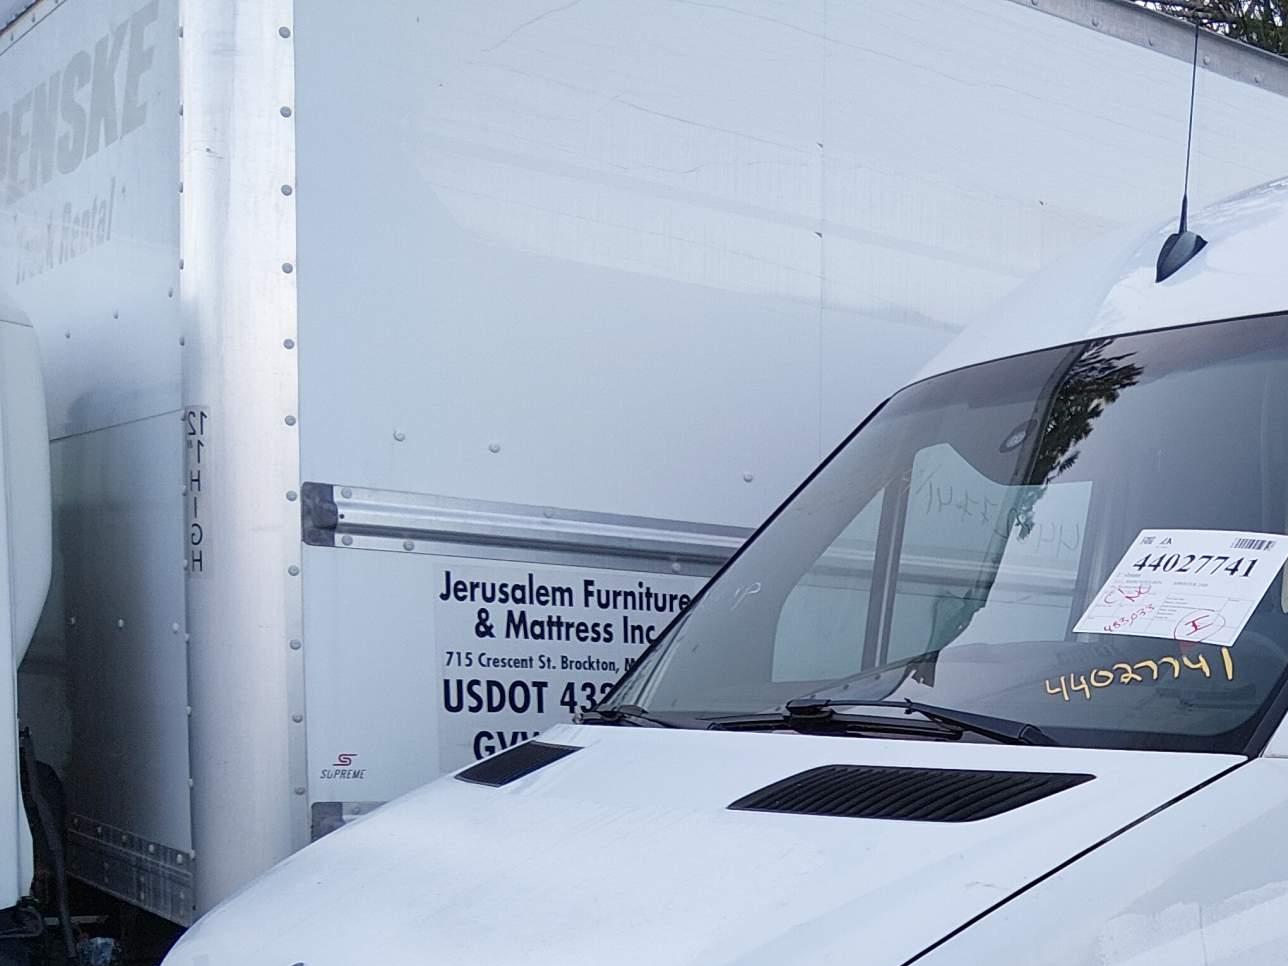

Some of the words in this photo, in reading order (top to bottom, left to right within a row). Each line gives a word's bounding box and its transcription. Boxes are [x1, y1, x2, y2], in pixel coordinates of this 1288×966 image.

[1132, 553, 1260, 578] 44027741
[440, 571, 574, 607] Jerusalem
[584, 580, 692, 612] Furniture
[475, 608, 496, 639] &
[505, 609, 614, 644] Mattress
[445, 652, 473, 667] 715
[478, 653, 533, 669] Crescent
[539, 655, 556, 670] St.
[561, 656, 619, 673] Brockton,
[1045, 647, 1233, 701] 44027741
[443, 678, 548, 714] USDOT
[320, 769, 367, 780] SUPREME
